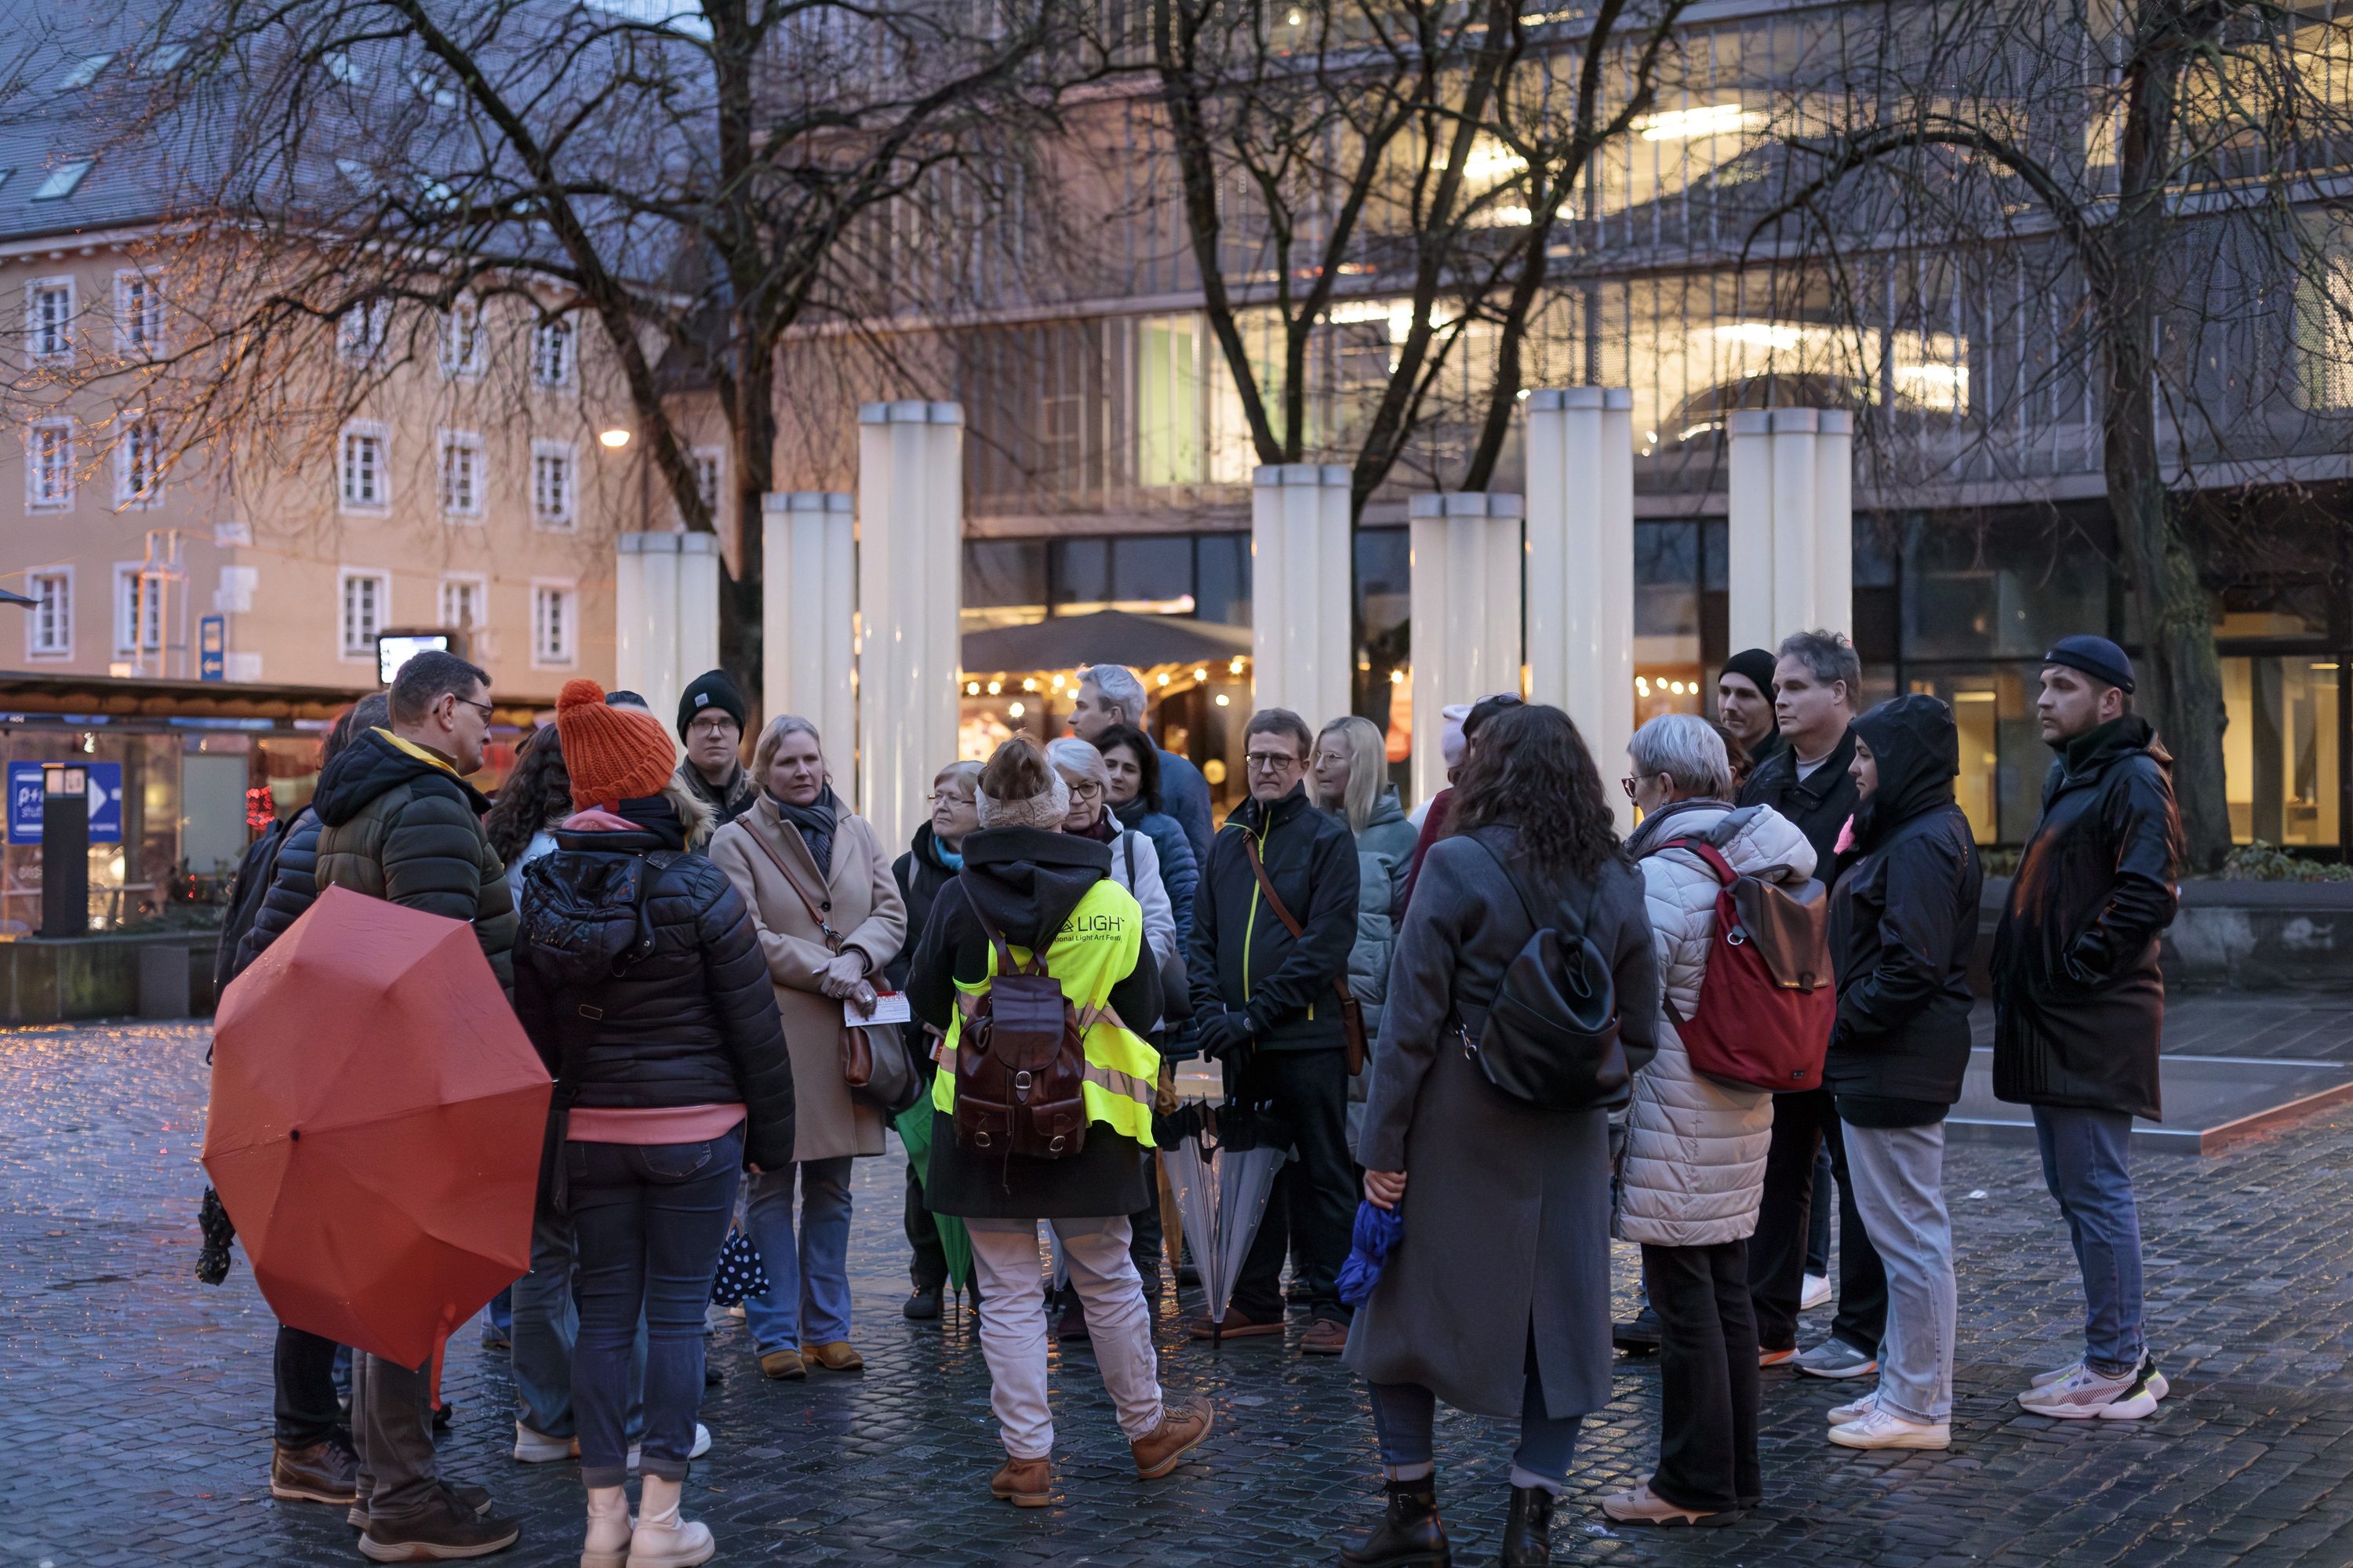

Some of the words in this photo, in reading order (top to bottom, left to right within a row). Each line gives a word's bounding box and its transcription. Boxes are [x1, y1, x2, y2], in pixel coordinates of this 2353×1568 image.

[1078, 915, 1125, 932] LIGH
[1075, 934, 1093, 943] Light
[1106, 934, 1122, 944] Festi
